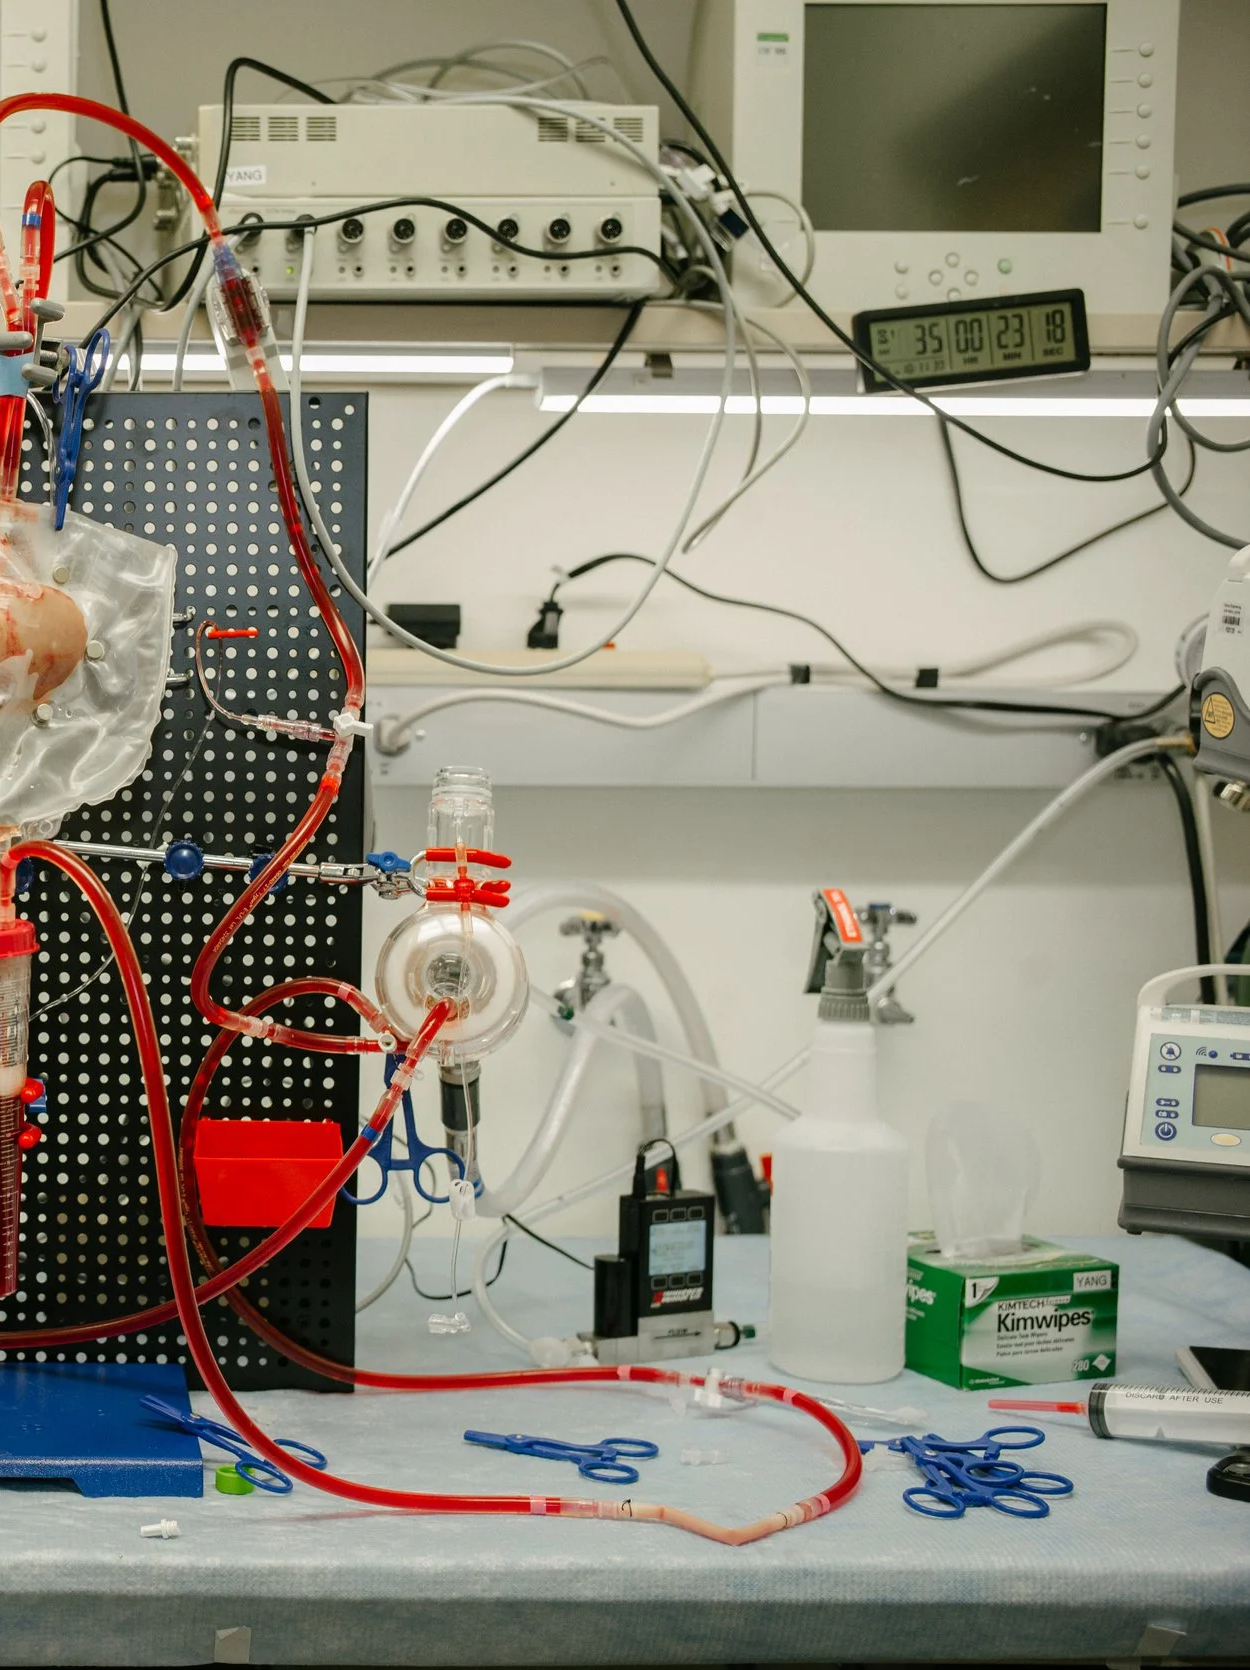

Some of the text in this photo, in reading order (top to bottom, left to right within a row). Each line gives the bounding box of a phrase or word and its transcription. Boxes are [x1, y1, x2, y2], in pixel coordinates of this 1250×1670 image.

[226, 169, 263, 182] YANG
[996, 314, 1024, 349] 23
[1046, 309, 1065, 344] 18
[915, 323, 943, 355] 35
[955, 318, 983, 353] 00
[1003, 351, 1022, 361] MIN
[1043, 347, 1063, 357] SEC
[1076, 1275, 1107, 1287] YANG
[997, 1300, 1045, 1312] KIMTECH
[997, 1308, 1092, 1333] Kimwipes
[1072, 1359, 1090, 1372] 280
[1125, 1391, 1224, 1404] DISCARD AFTER USE
